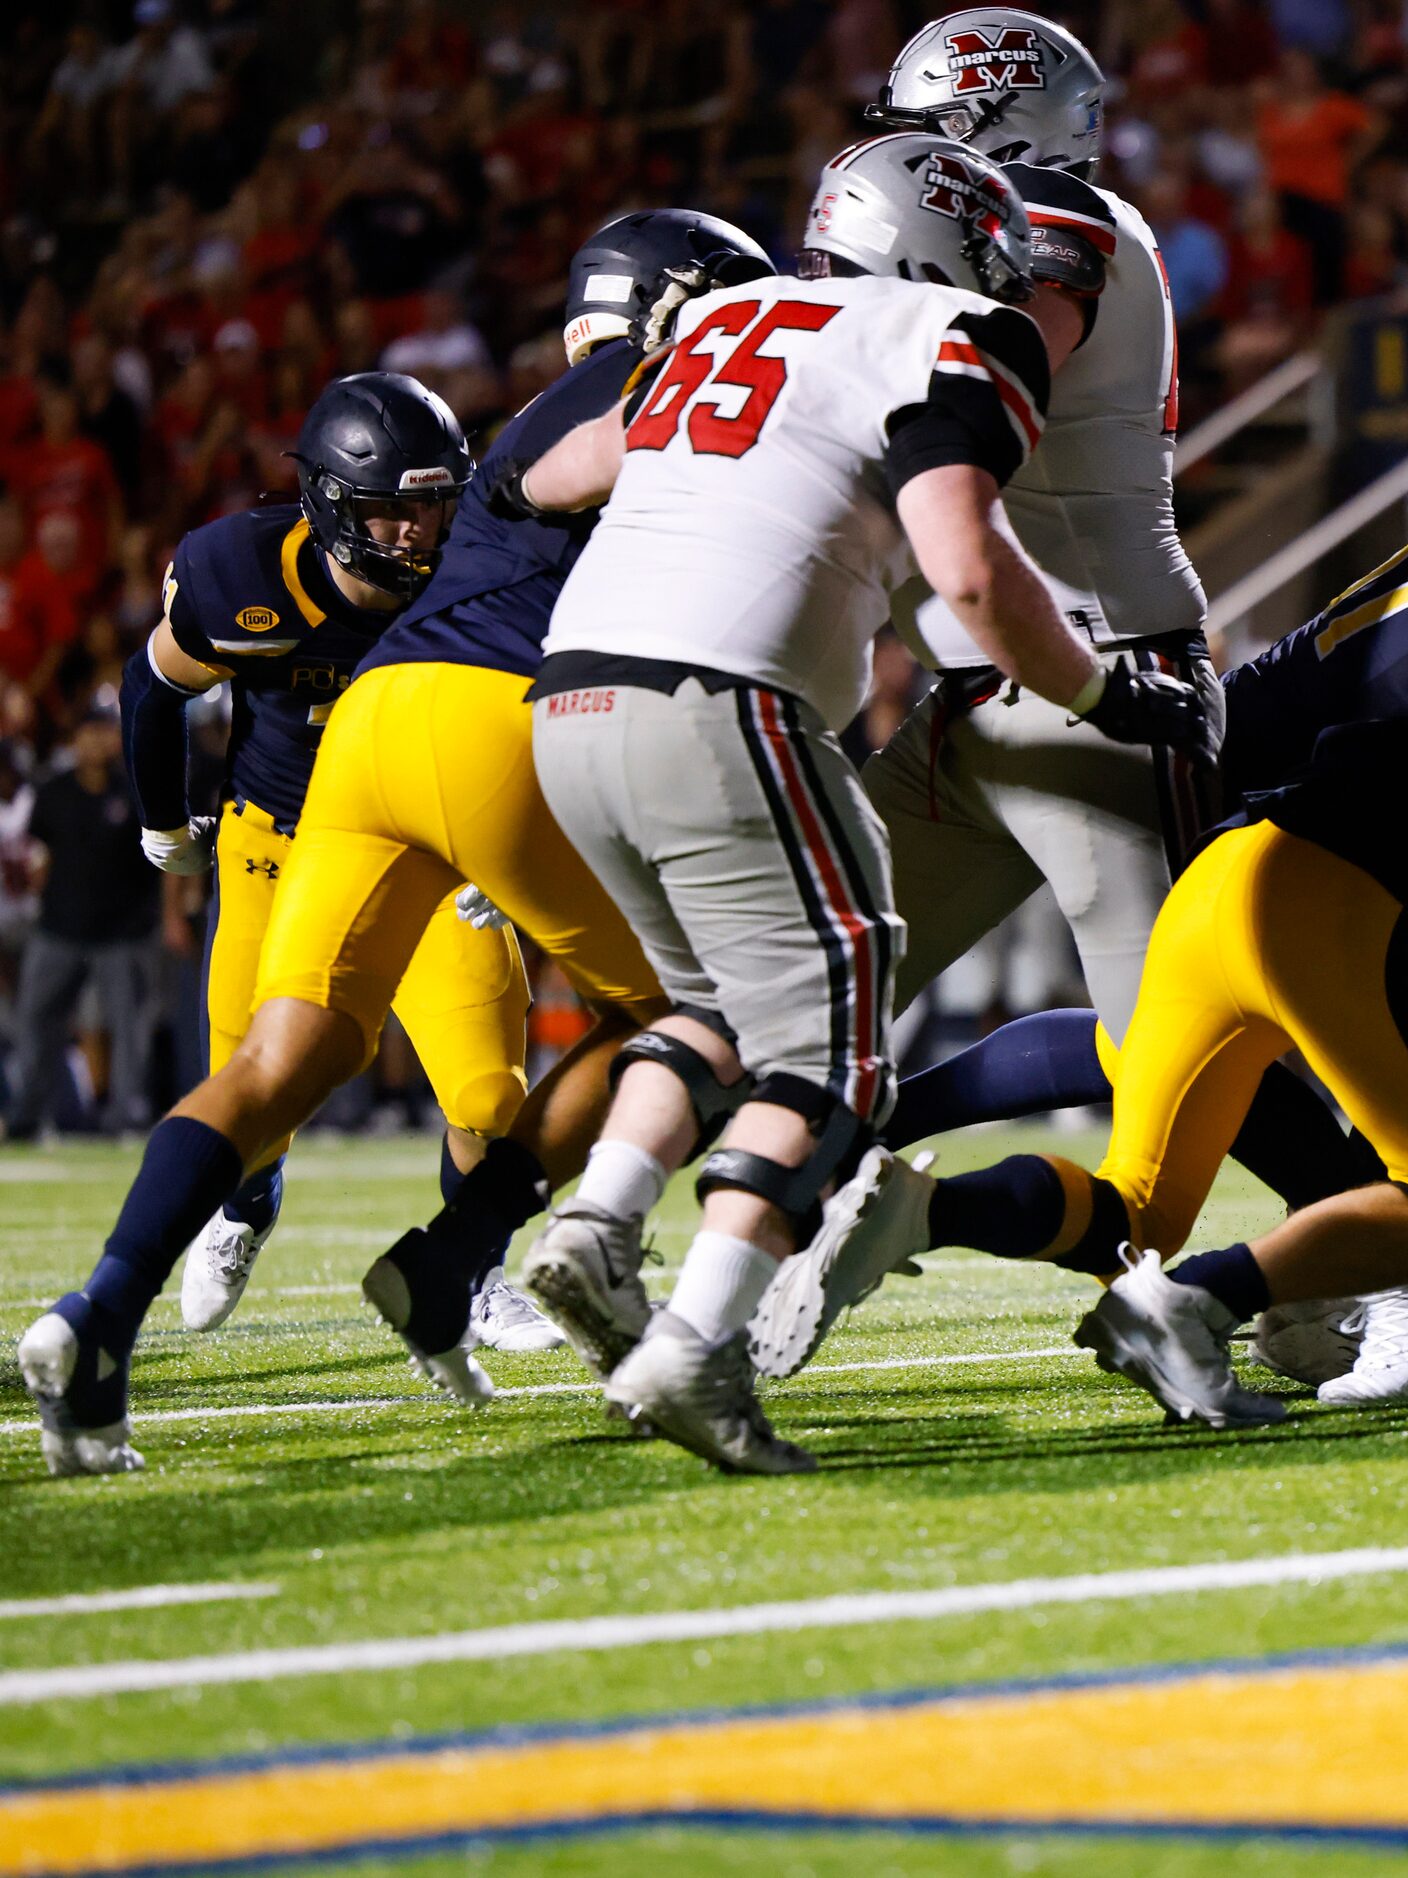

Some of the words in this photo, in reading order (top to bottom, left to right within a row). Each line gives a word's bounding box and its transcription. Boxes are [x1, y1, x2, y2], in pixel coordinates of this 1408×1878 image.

[944, 27, 1046, 98] M
[950, 50, 1040, 70] marcus
[919, 151, 1011, 240] M
[927, 172, 1009, 219] marcus
[626, 299, 844, 460] 65
[247, 614, 269, 625] 100
[546, 690, 616, 717] MARCUS
